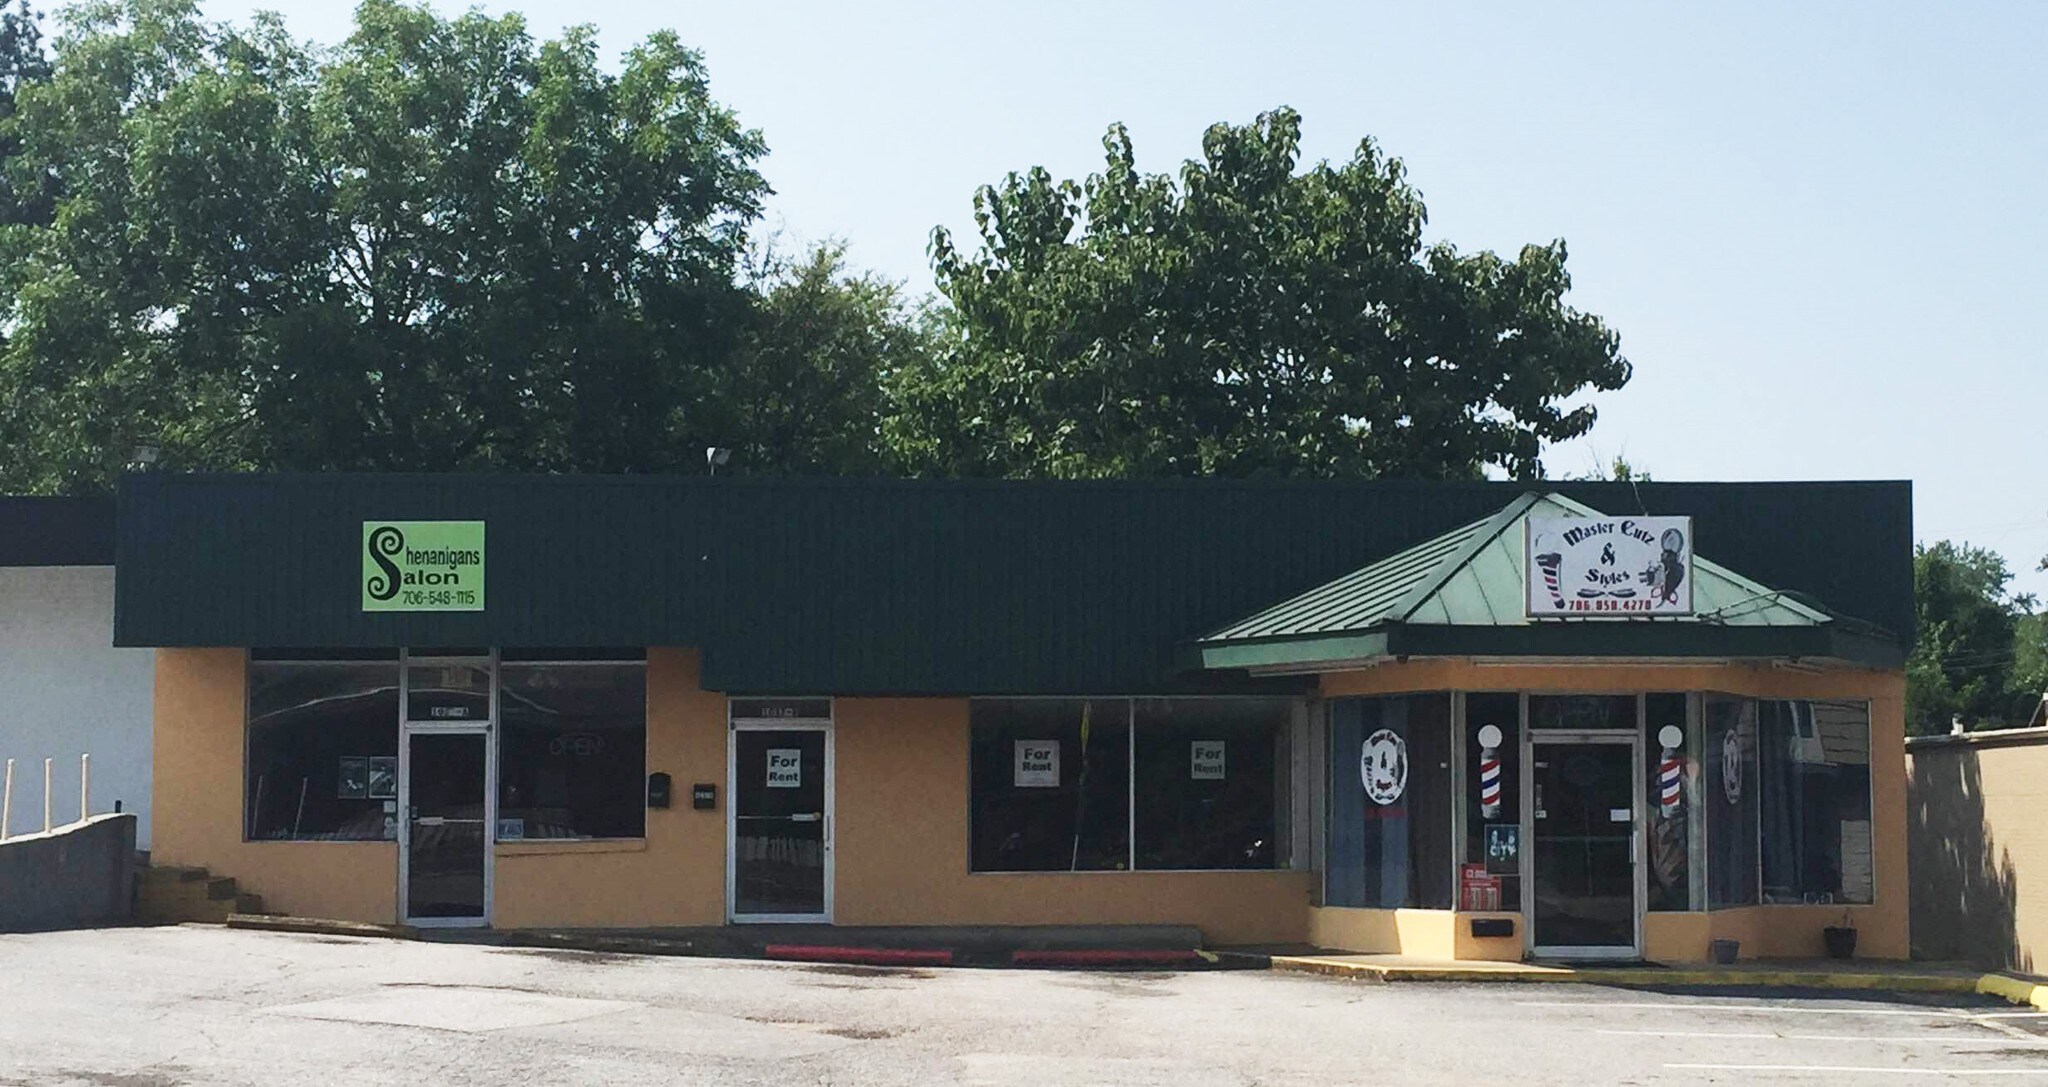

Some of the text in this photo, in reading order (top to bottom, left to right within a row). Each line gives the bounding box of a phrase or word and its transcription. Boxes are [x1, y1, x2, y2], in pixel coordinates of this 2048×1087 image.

[1563, 520, 1655, 547] Master Cutz
[1600, 542, 1615, 566] &
[368, 526, 480, 601] Shenanigans
[1585, 569, 1630, 588] Styles
[402, 590, 475, 605] 706-548-1115
[1024, 748, 1051, 760] For
[1195, 747, 1222, 760] For
[770, 755, 798, 768] For
[1022, 761, 1052, 772] Rent
[1194, 763, 1223, 774] Rent
[769, 771, 799, 782] Rent
